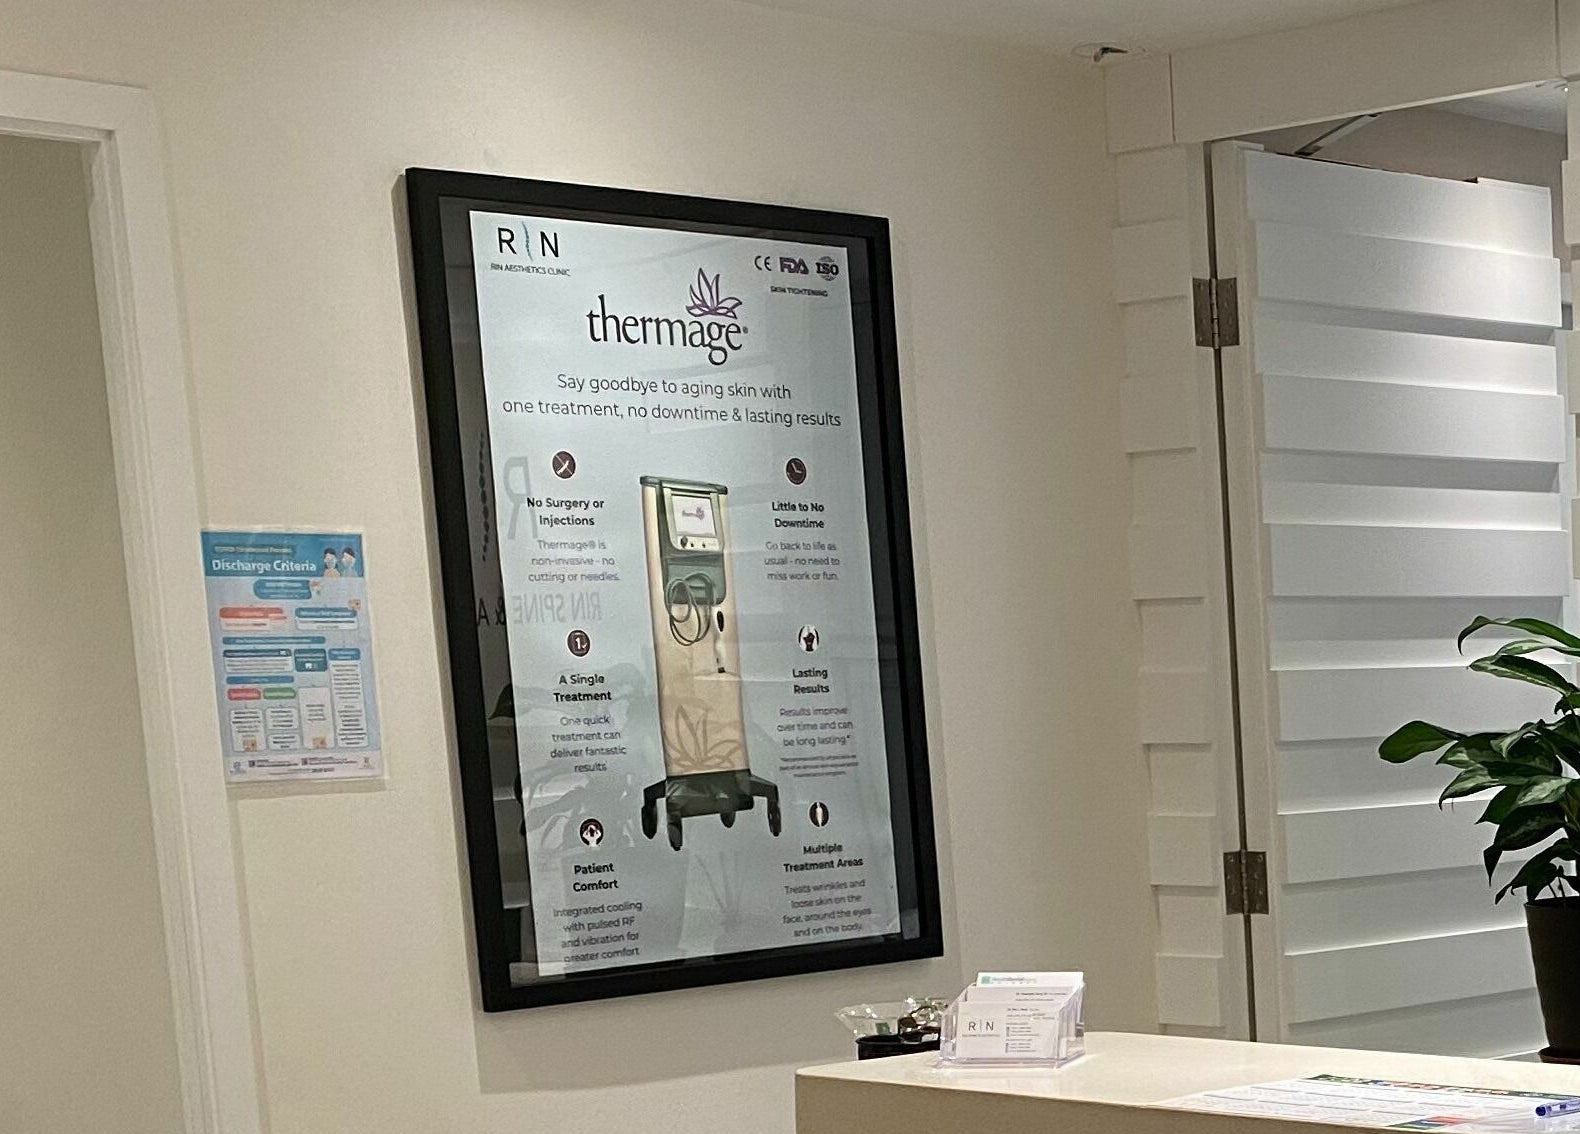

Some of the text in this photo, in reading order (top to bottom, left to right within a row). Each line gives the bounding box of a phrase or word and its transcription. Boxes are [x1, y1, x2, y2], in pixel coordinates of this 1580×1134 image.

[490, 262, 571, 276] RIN AESTHETICS CLINIC
[779, 257, 809, 274] FDA
[815, 261, 839, 276] ISO
[557, 373, 791, 399] Say goodbye to aging skin with
[502, 400, 842, 428] one treatment, no downtime & lasting results
[527, 497, 605, 510] No Surgery or
[771, 500, 825, 513] Little to No
[539, 515, 595, 527] Injections
[774, 517, 825, 529] Downtime
[598, 540, 607, 550] is
[765, 541, 837, 551] Go back to life as
[211, 559, 317, 574] Discharge Criteria
[531, 557, 594, 566] non-invasive
[601, 557, 615, 565] no
[764, 556, 788, 566] usual
[795, 558, 807, 566] no
[808, 557, 829, 566] need
[831, 557, 840, 566] to
[528, 572, 565, 584] cutting
[567, 573, 578, 581] or
[789, 571, 811, 580] work
[822, 571, 839, 581] fun.
[792, 667, 828, 679] Lasting
[559, 673, 605, 686] A Single
[794, 684, 830, 694] Results
[553, 691, 612, 702] Treatment
[560, 715, 610, 726] One quick
[777, 721, 853, 731] over time and can
[552, 731, 621, 742] treatment can
[783, 738, 794, 746] be
[796, 737, 816, 747] long
[550, 745, 627, 759] deliver fantastic
[574, 762, 607, 773] results
[803, 843, 843, 855] Multiple
[574, 863, 614, 875] Patient
[783, 858, 864, 872] Treatment Areas
[573, 879, 619, 892] Comfort
[784, 879, 866, 895] Treats wrinkles and
[791, 900, 814, 909] loose
[815, 897, 833, 907] skin
[846, 894, 862, 903] the
[553, 901, 643, 918] Integrated cooling
[804, 911, 835, 922] around
[836, 909, 851, 918] the
[852, 907, 872, 917] eyes
[563, 916, 635, 932] with pulsed RF
[793, 927, 810, 937] and
[811, 928, 823, 936] on
[825, 926, 839, 934] the
[561, 931, 640, 948] and vibration for
[601, 947, 640, 959] comfort
